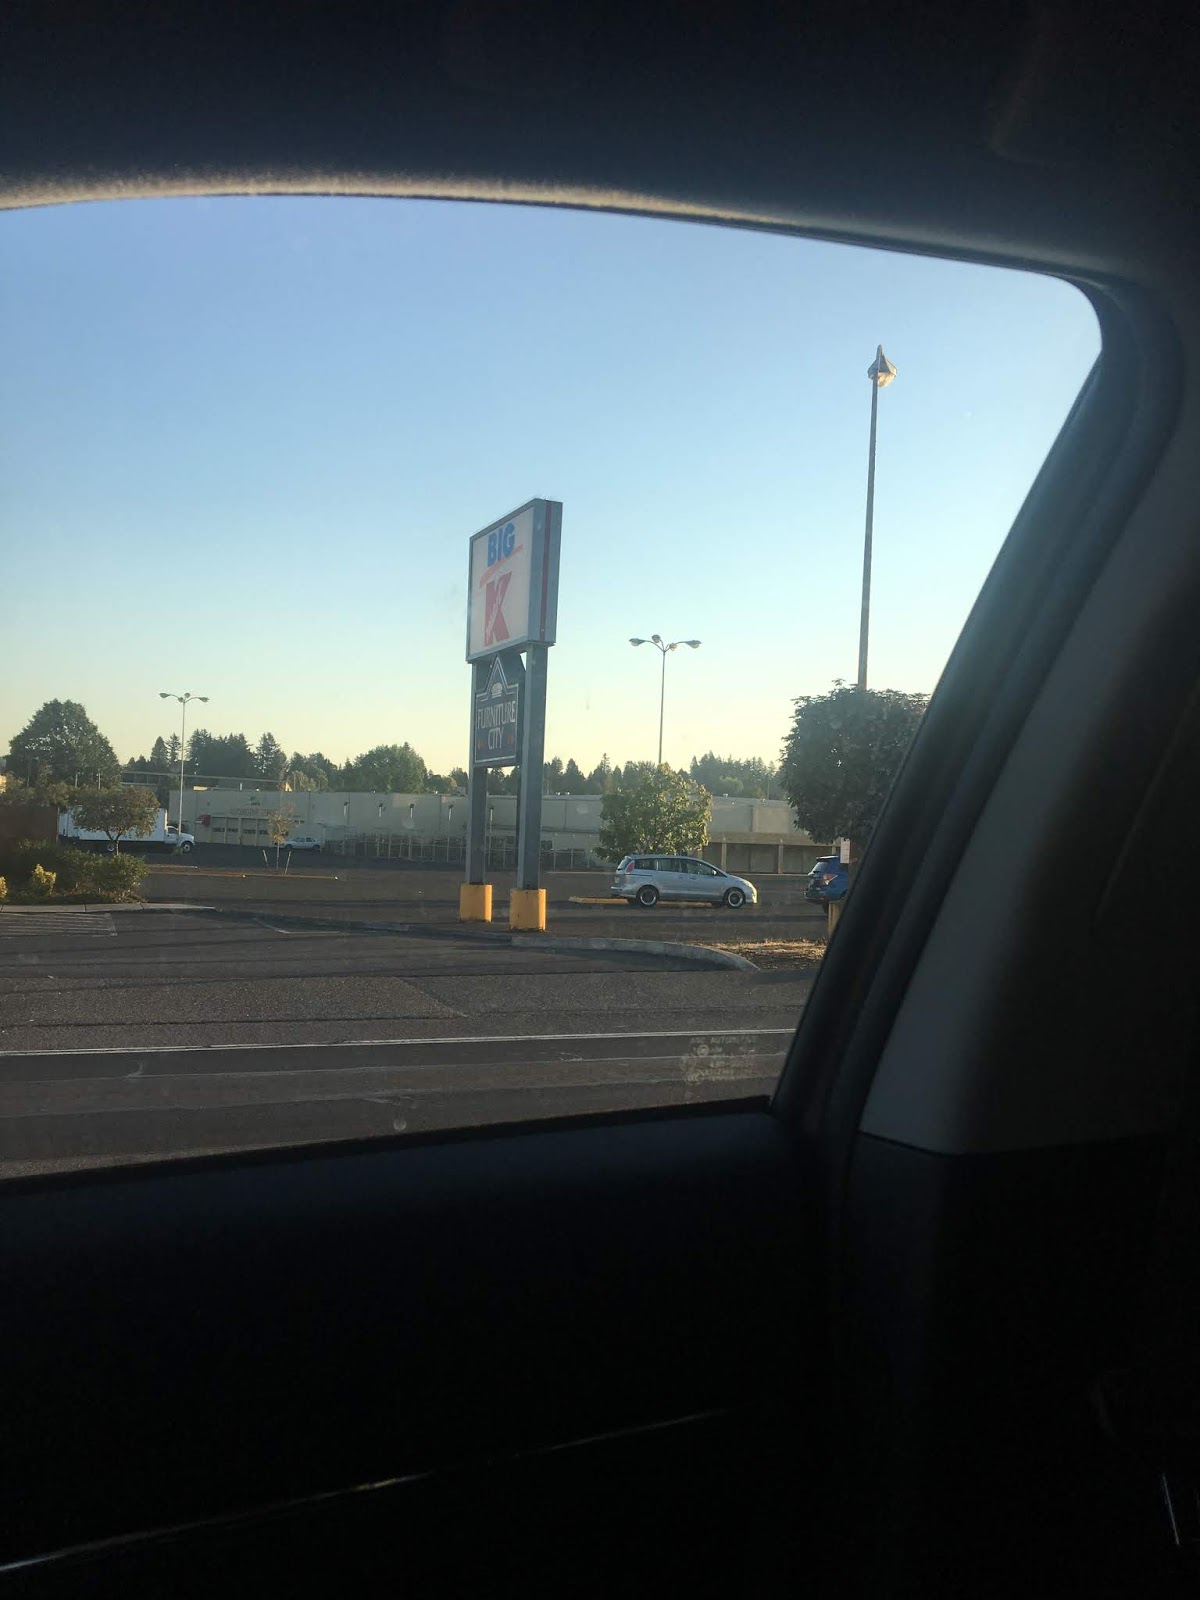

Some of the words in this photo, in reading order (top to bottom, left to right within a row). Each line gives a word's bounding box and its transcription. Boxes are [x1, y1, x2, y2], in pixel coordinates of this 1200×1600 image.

[487, 523, 515, 567] BIG
[485, 571, 512, 646] K
[478, 701, 516, 730] FURNITURE
[488, 727, 504, 749] CITY
